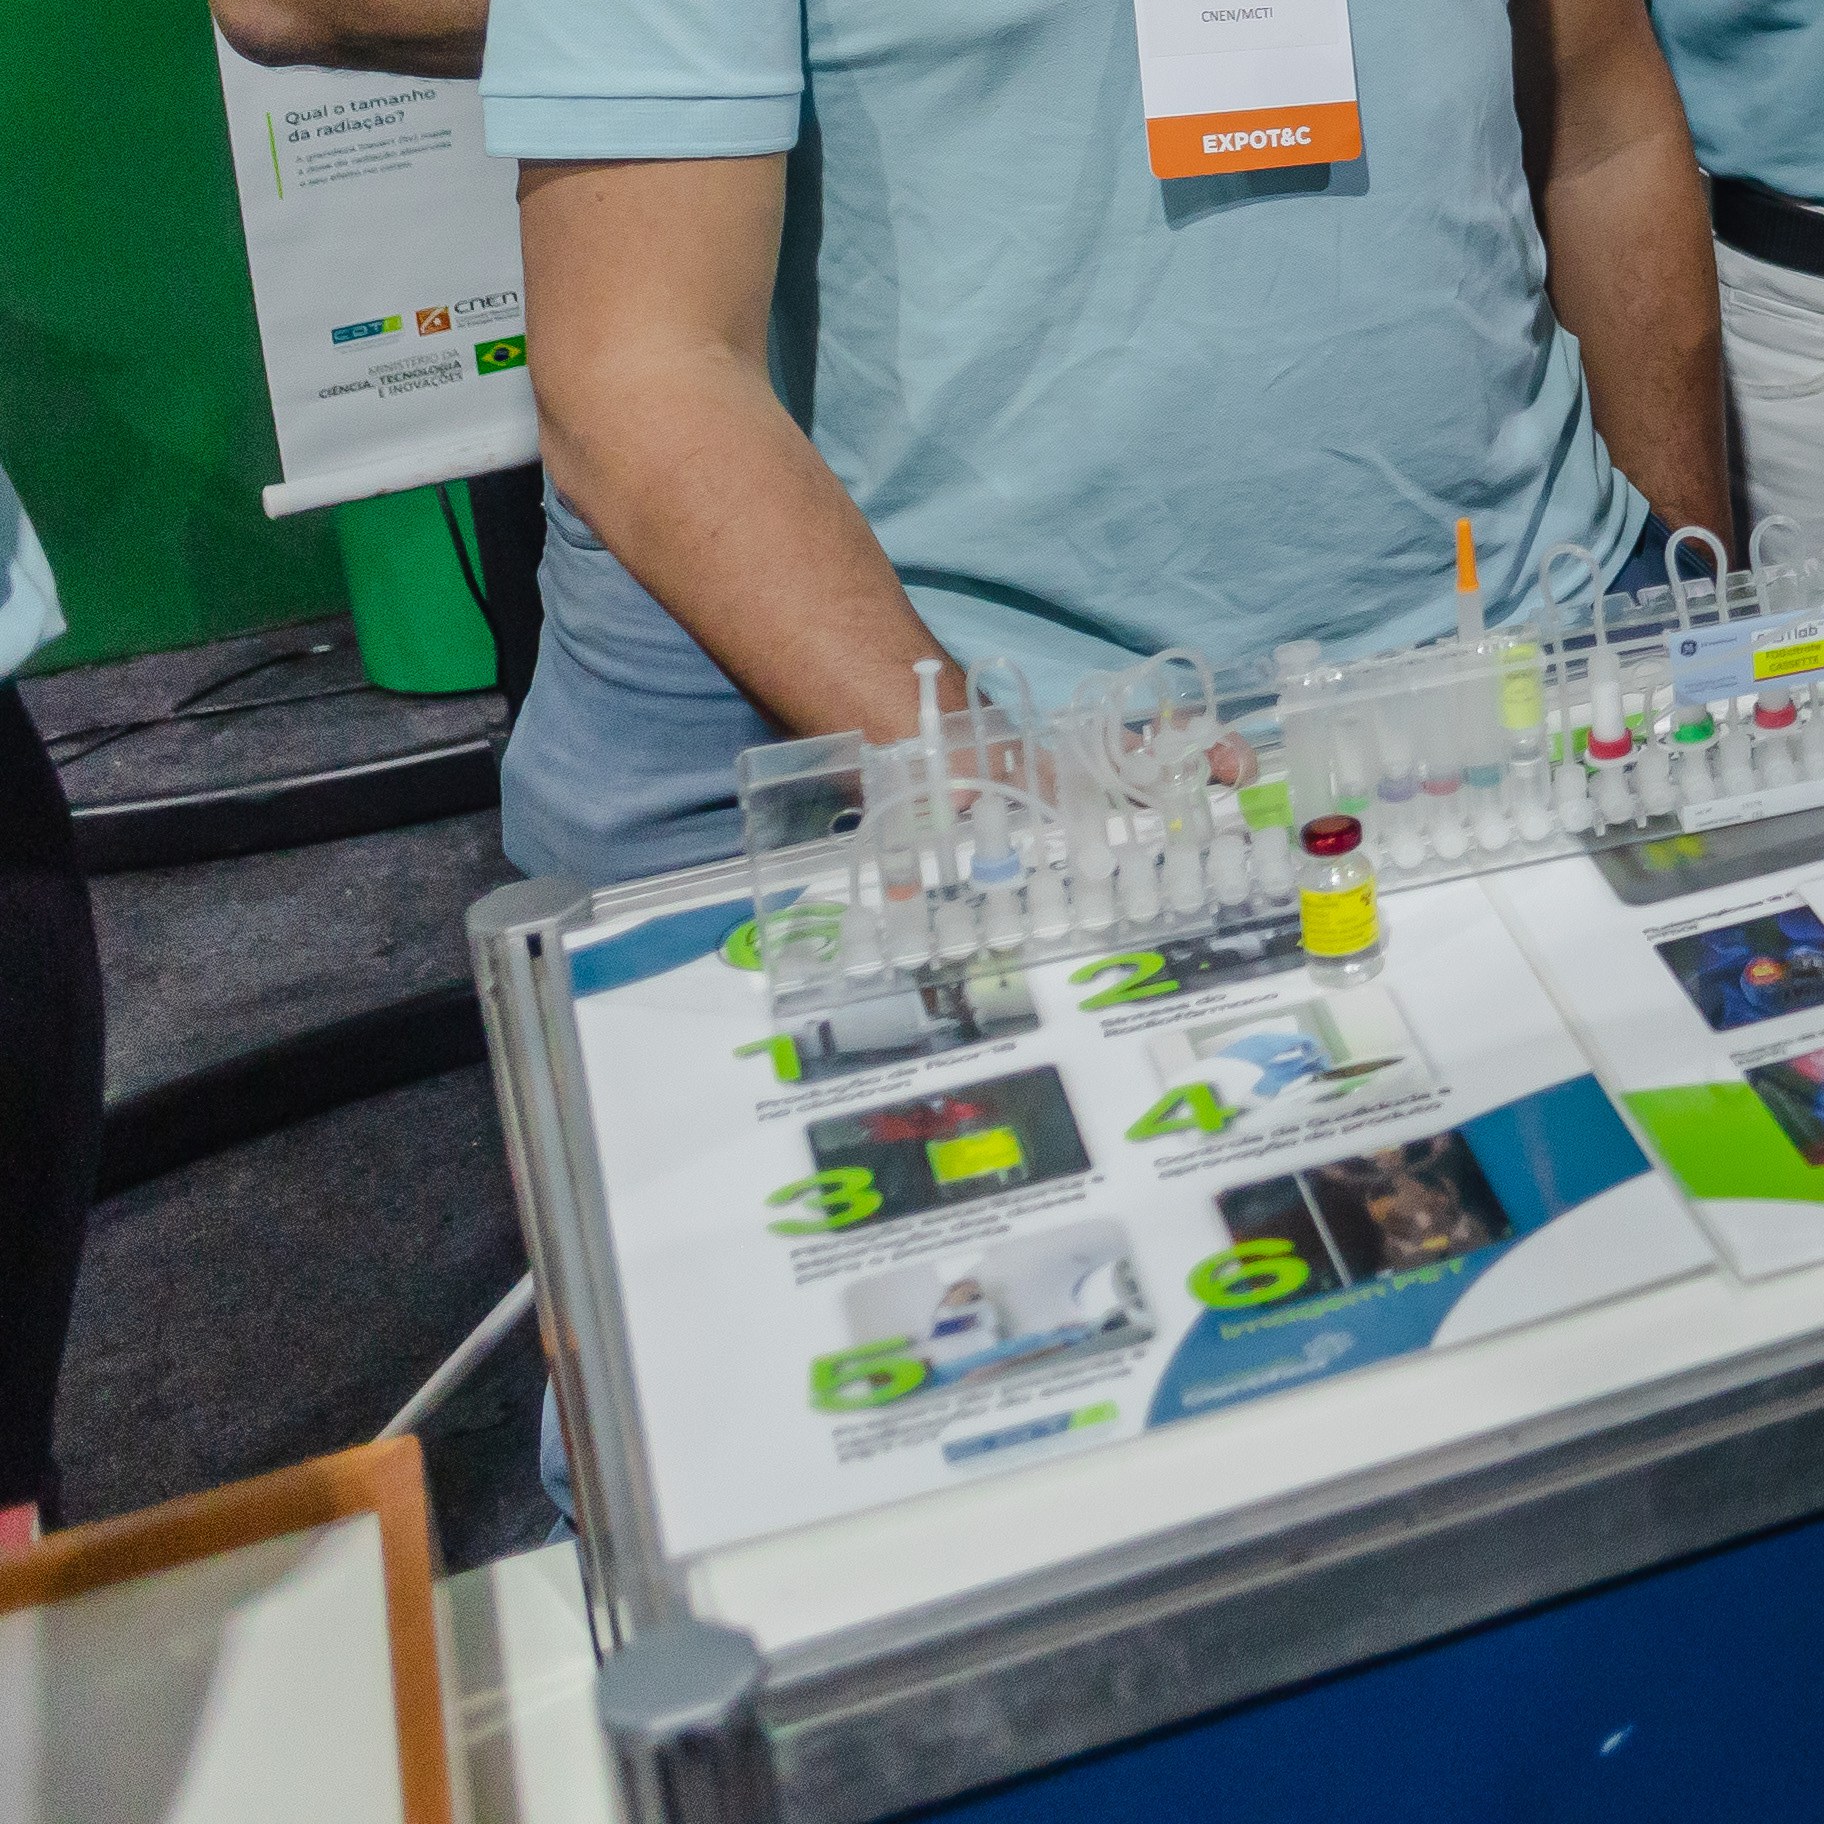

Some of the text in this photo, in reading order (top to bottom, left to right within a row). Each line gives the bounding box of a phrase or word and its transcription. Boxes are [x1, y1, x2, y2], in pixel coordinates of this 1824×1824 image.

[1201, 7, 1273, 23] CNEN/MCTI
[285, 89, 436, 126] Qual o tamanho
[288, 110, 405, 143] da radiação?
[1202, 126, 1312, 154] EXPOT&C
[1068, 951, 1180, 1012] 2
[733, 1033, 801, 1083] 1
[1124, 1083, 1240, 1143] 4
[765, 1166, 884, 1236] 3
[1186, 1237, 1311, 1309] 6
[808, 1334, 925, 1414] 5
